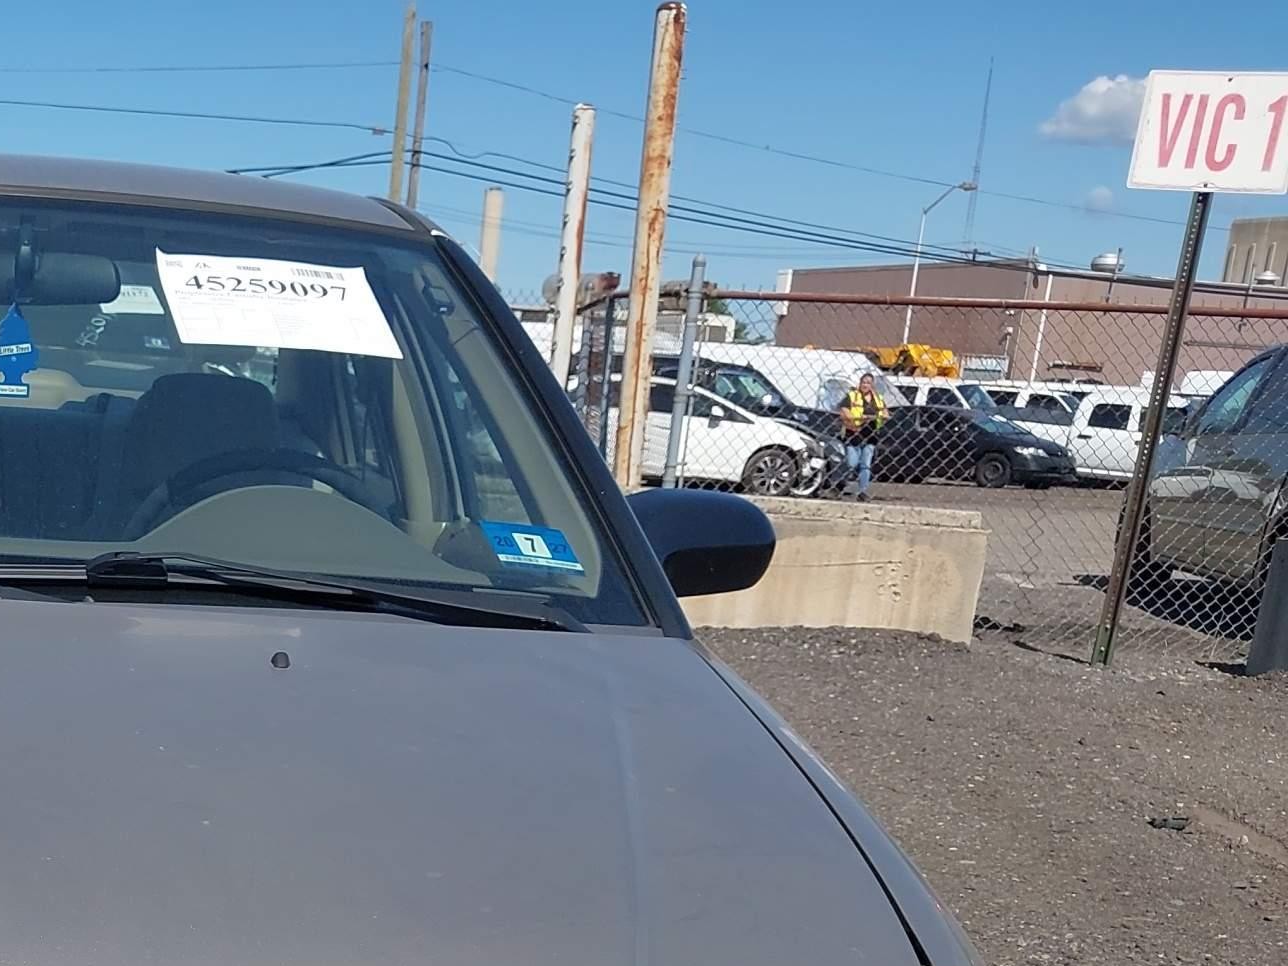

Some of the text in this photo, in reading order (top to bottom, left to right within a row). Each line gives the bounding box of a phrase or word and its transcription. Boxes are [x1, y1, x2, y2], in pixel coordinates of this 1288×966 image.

[1157, 92, 1288, 172] VIC 1
[185, 274, 347, 302] 45259097
[0, 345, 30, 355] Little Trees
[524, 537, 536, 553] 7
